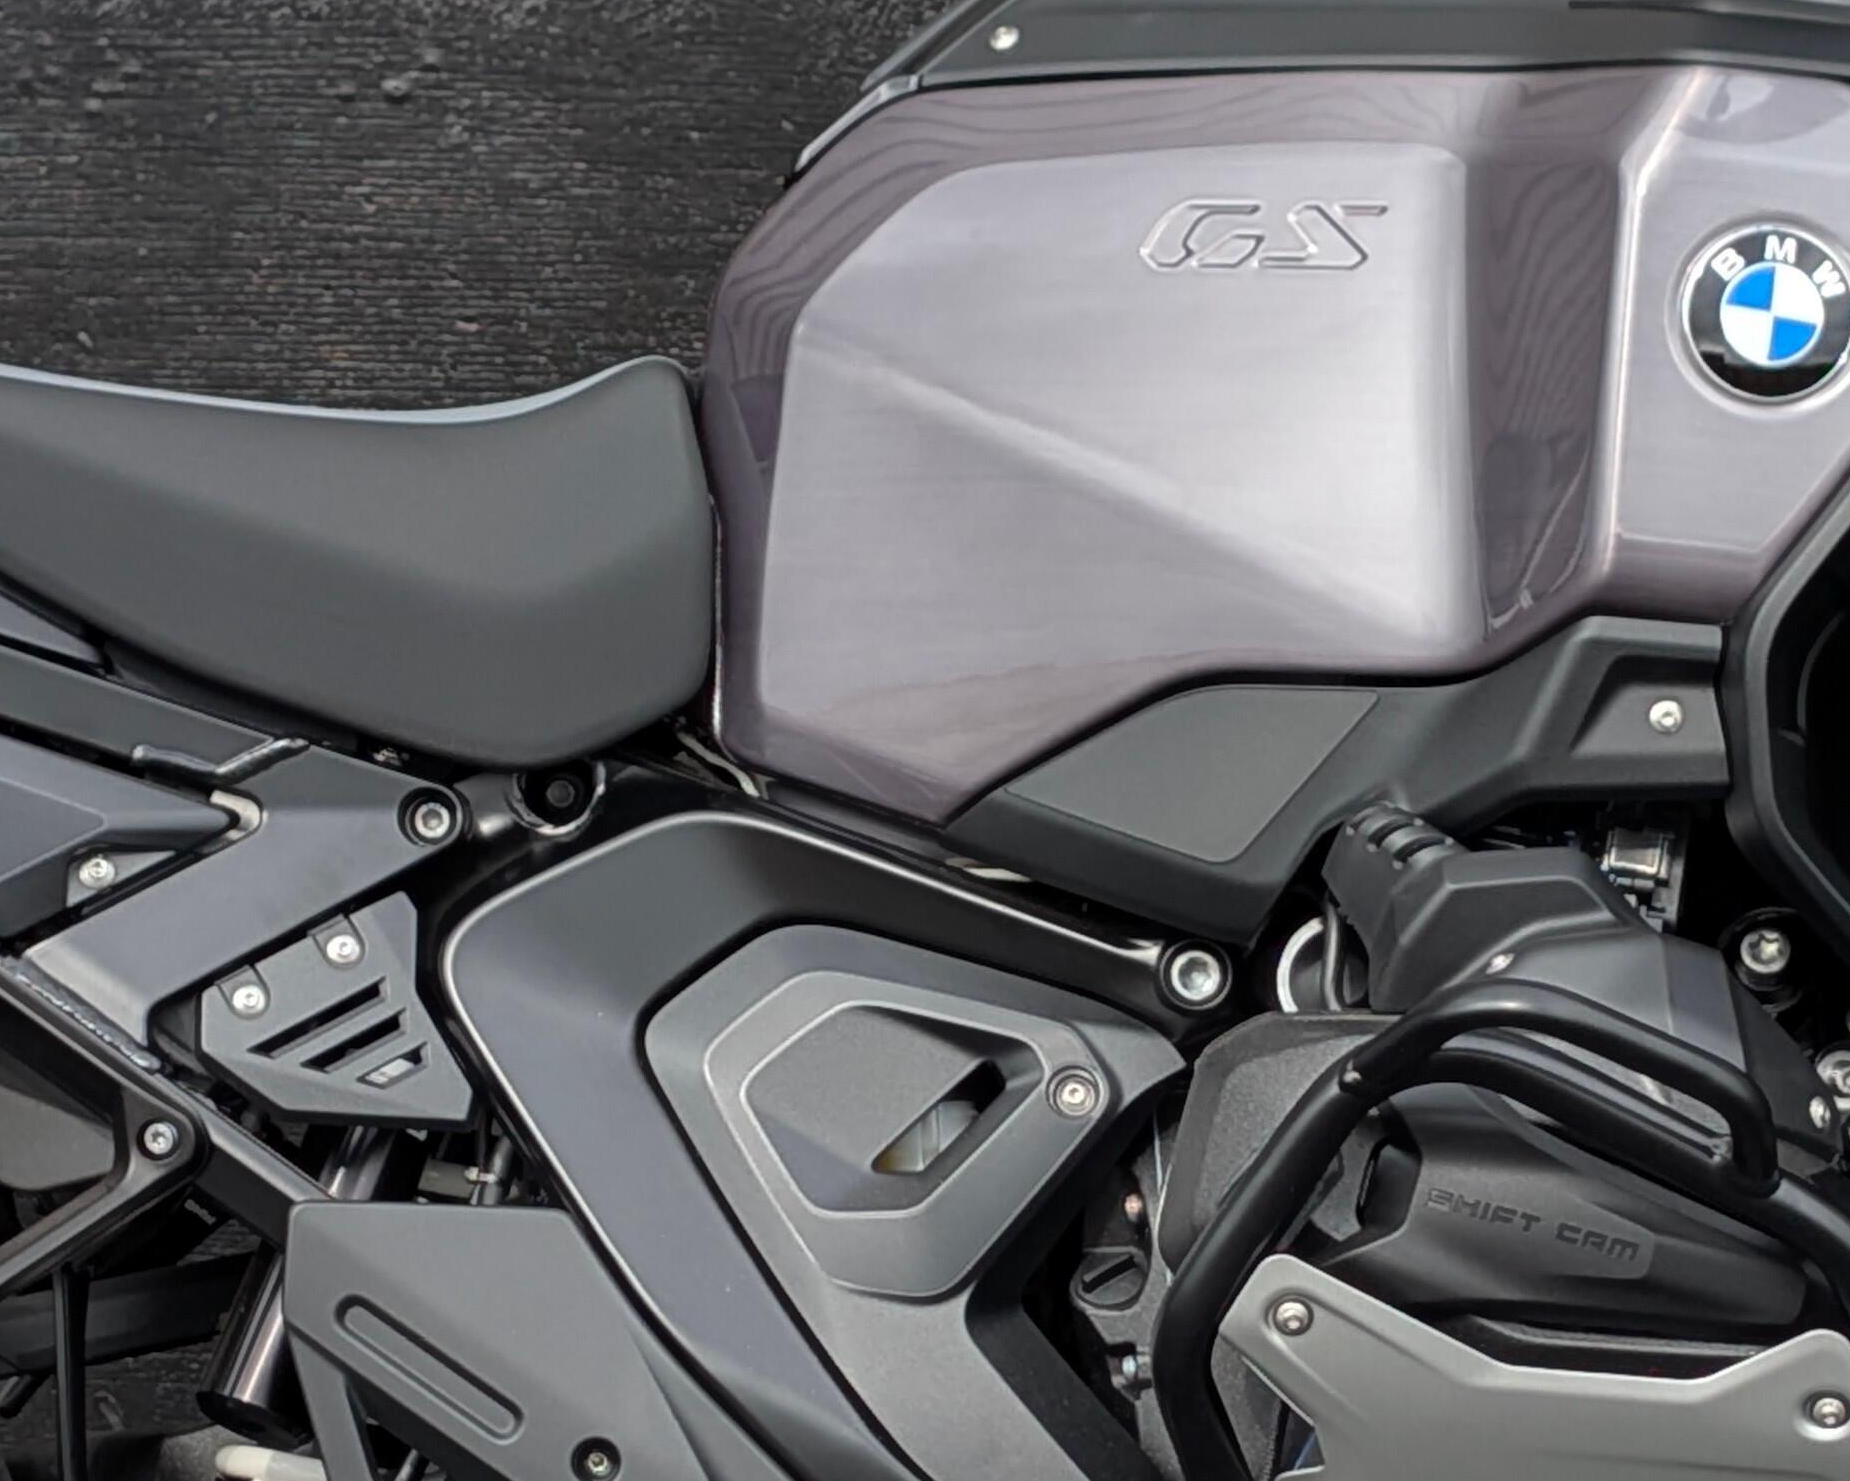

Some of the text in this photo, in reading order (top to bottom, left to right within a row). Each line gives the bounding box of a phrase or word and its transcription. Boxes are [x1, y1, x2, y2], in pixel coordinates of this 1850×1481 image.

[1139, 199, 1390, 271] GS
[1710, 234, 1847, 299] BMW
[1425, 1186, 1641, 1264] SHIFT CAM
